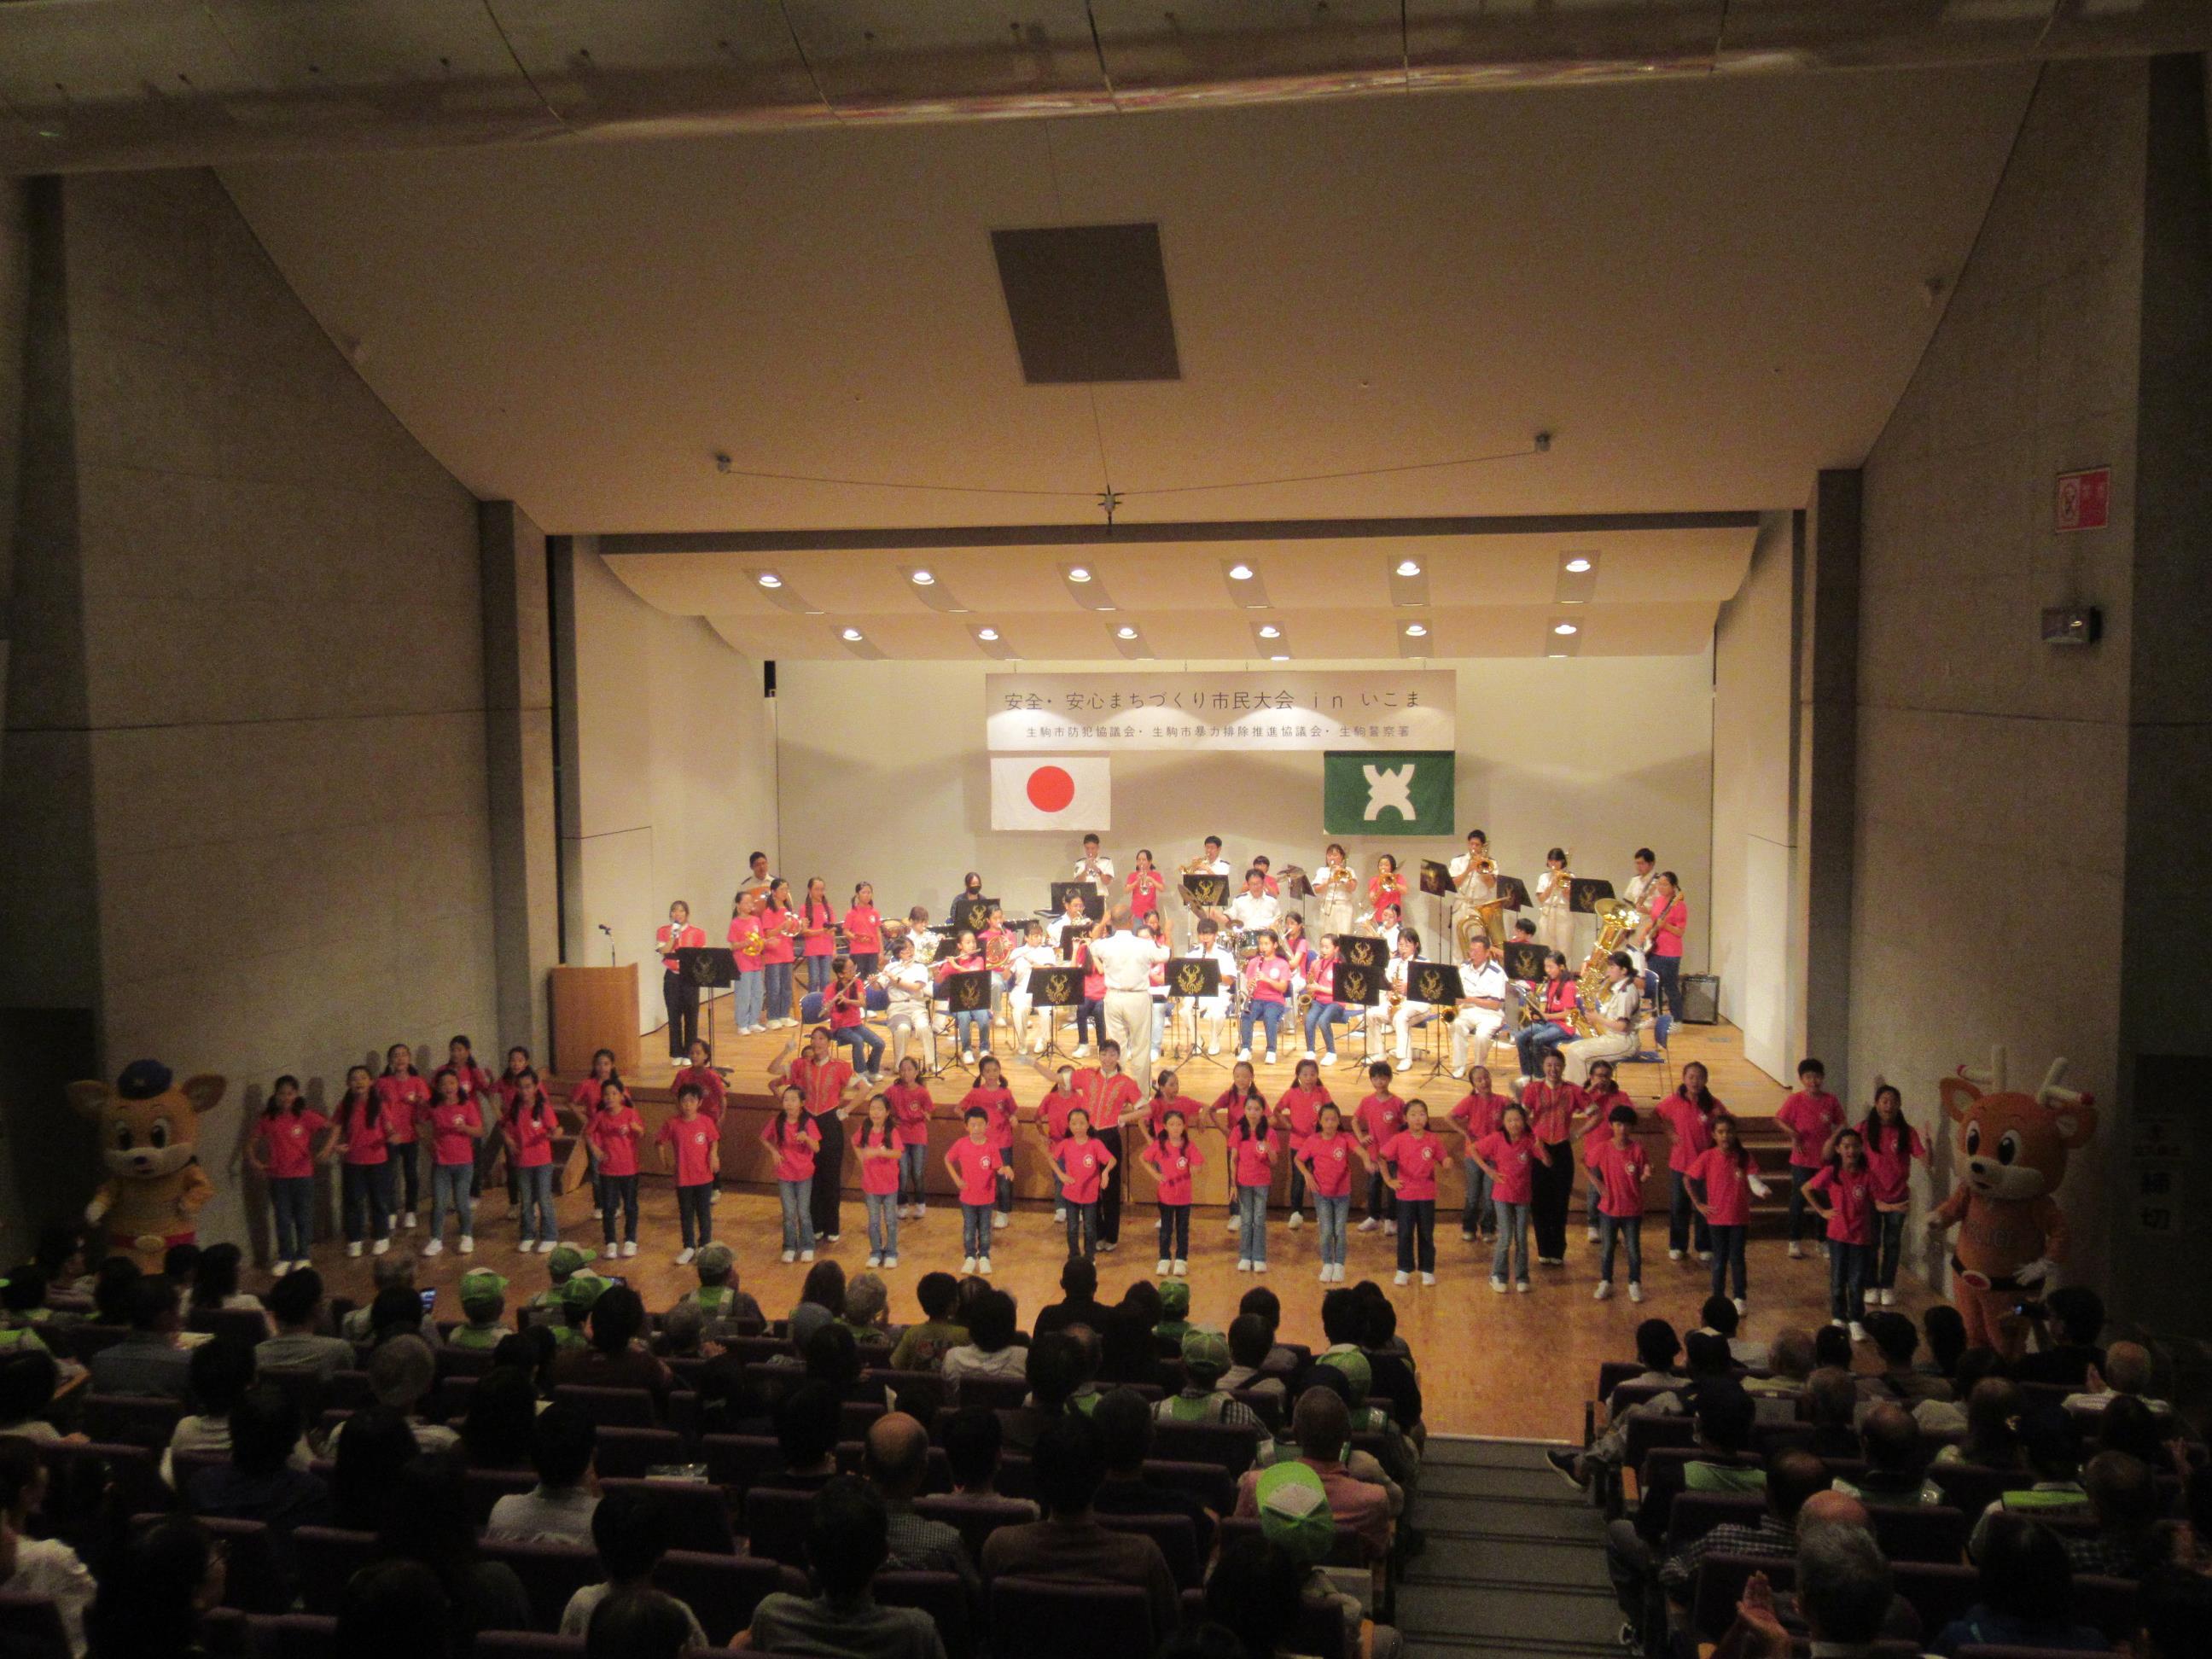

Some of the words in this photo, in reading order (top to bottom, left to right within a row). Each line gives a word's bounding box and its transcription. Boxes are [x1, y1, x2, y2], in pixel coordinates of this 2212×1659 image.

[1314, 691, 1342, 708] in
[1361, 691, 1419, 707] いこま
